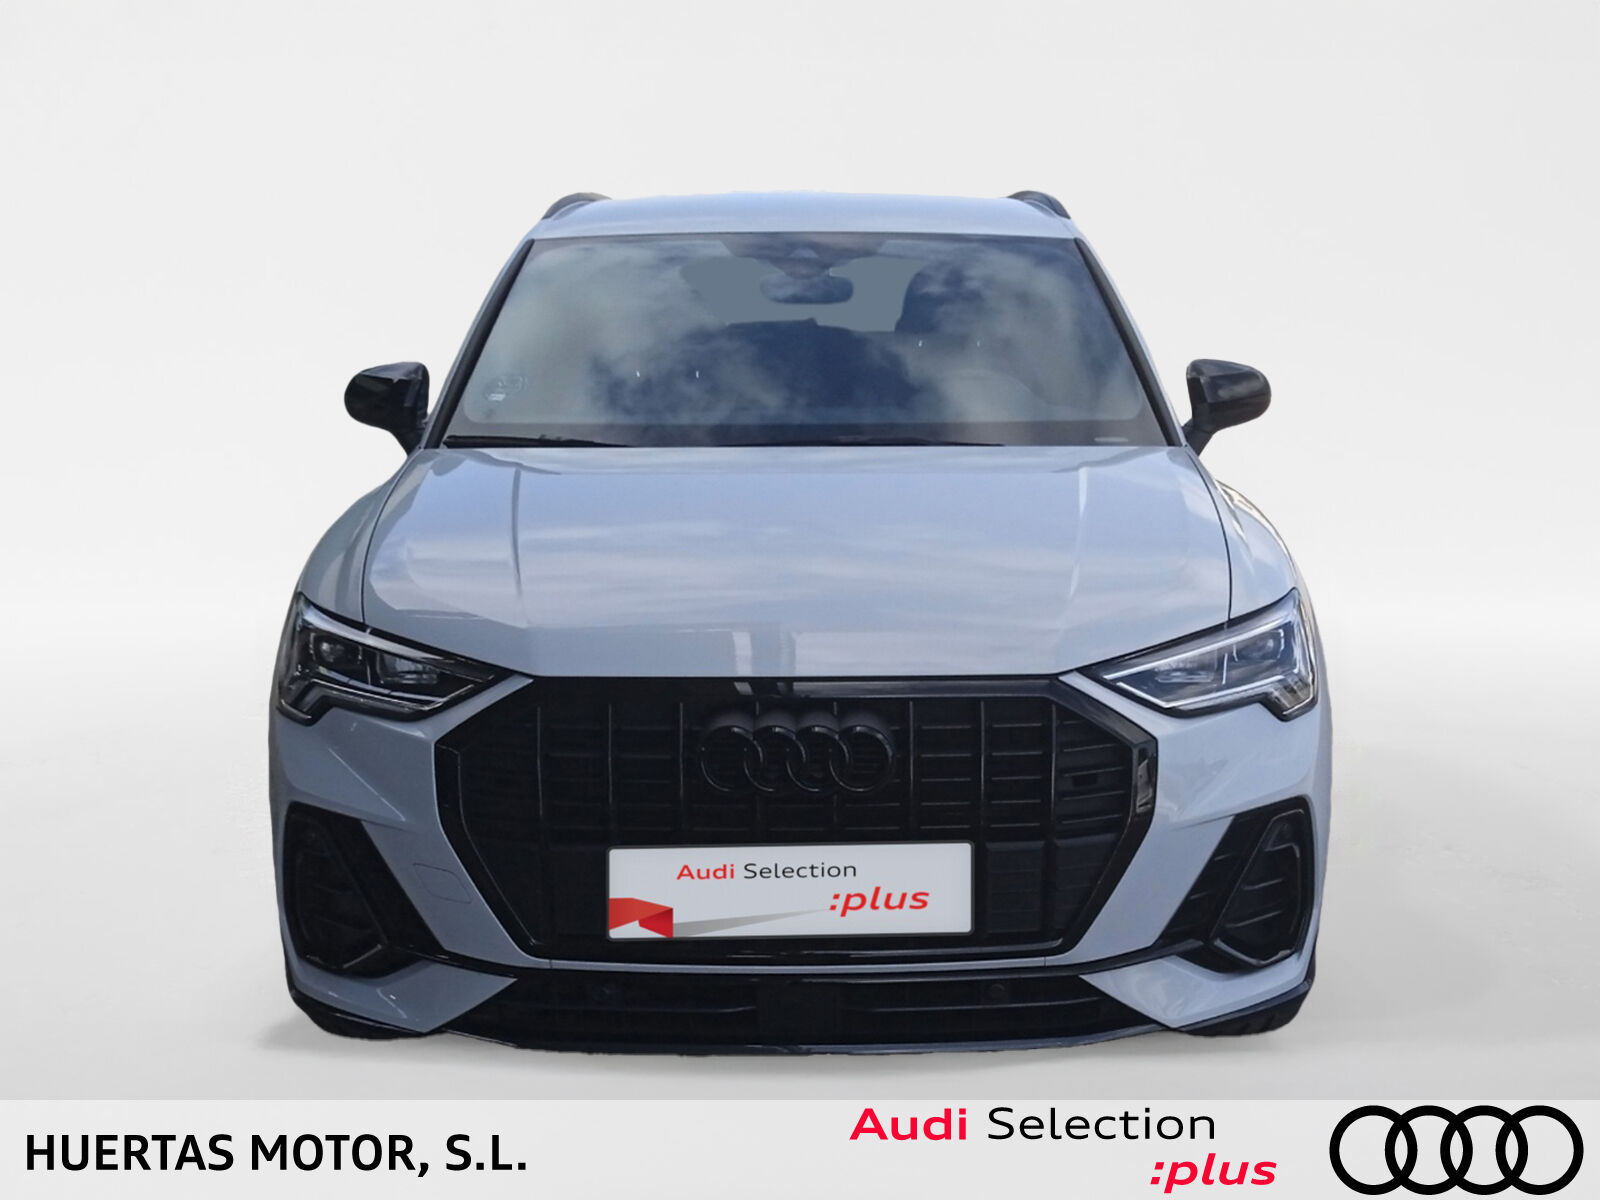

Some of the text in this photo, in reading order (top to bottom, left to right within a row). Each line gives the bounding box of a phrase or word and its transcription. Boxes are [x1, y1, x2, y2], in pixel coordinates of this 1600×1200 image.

[676, 862, 858, 881] Audi Selection
[829, 886, 930, 918] :plus
